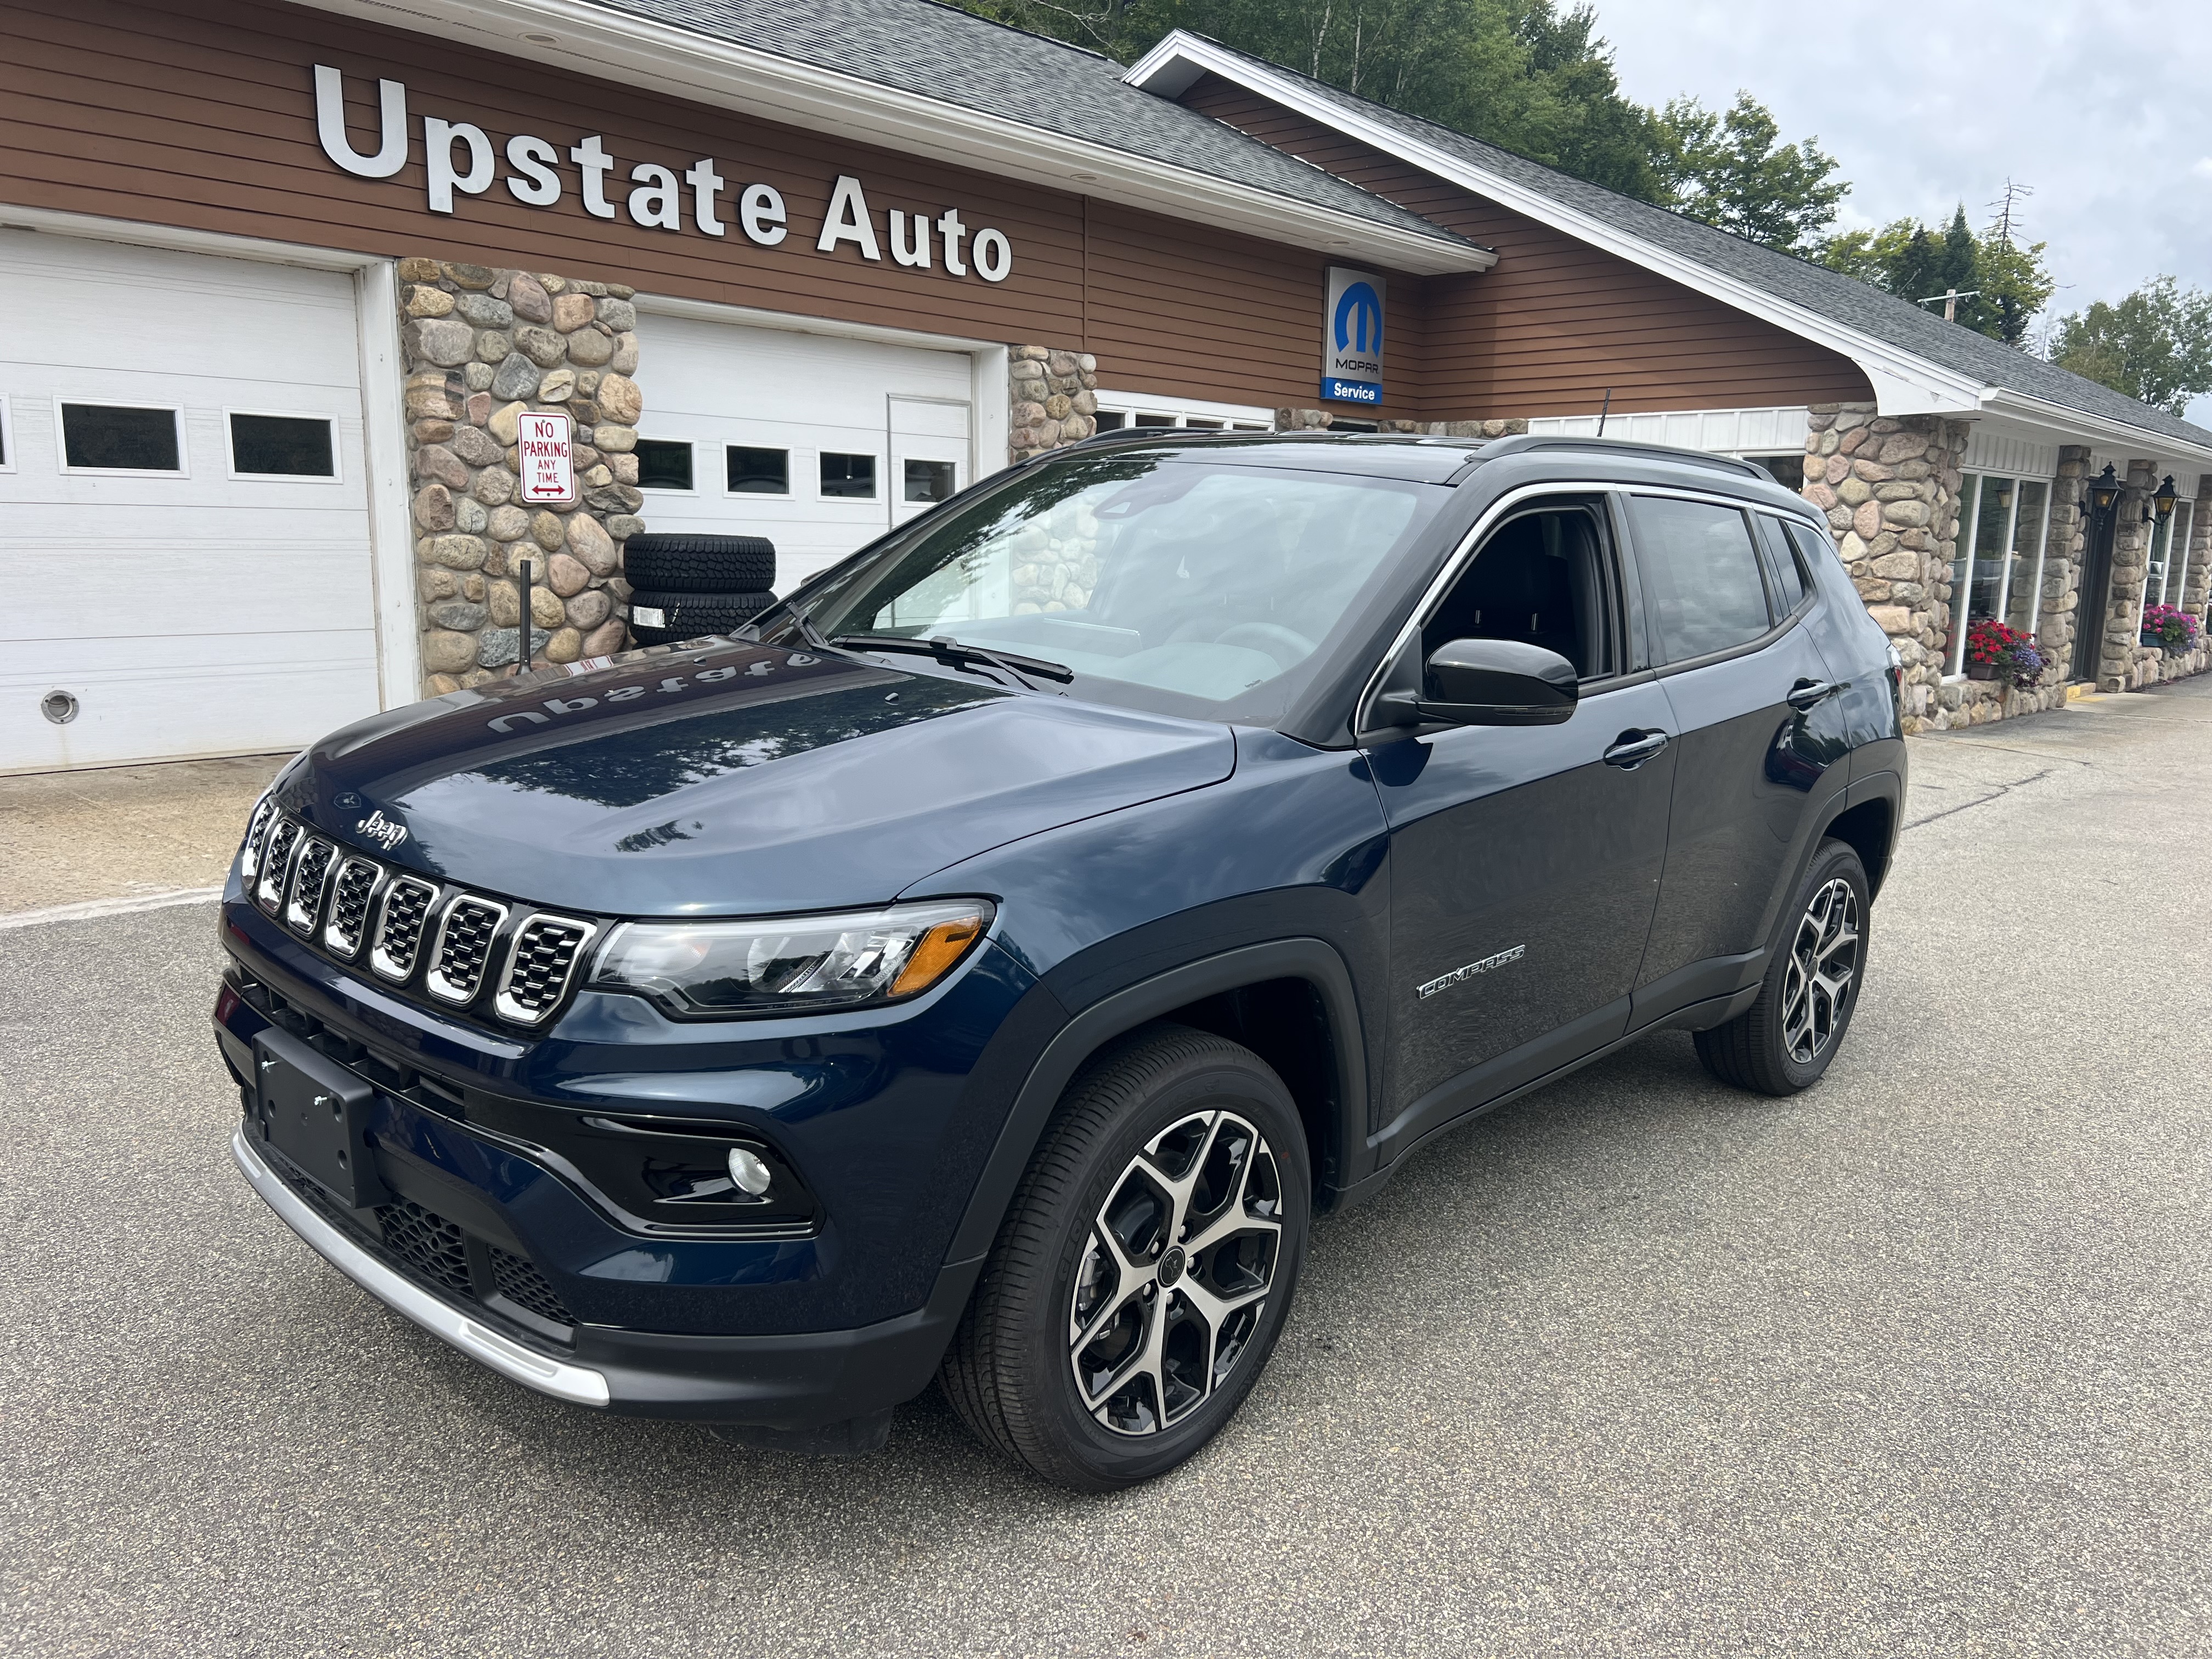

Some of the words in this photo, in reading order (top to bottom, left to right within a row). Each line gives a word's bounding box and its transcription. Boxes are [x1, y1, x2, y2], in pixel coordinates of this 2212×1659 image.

[313, 64, 788, 246] Upstate
[817, 174, 1012, 283] Auto
[1335, 358, 1379, 374] MOPAR
[1334, 382, 1375, 400] Service
[535, 422, 554, 438] NO
[524, 441, 567, 458] PARKING
[538, 460, 556, 470] ANY
[537, 472, 559, 483] TIME
[356, 810, 408, 850] Jeep
[1416, 944, 1525, 1000] COMPASS
